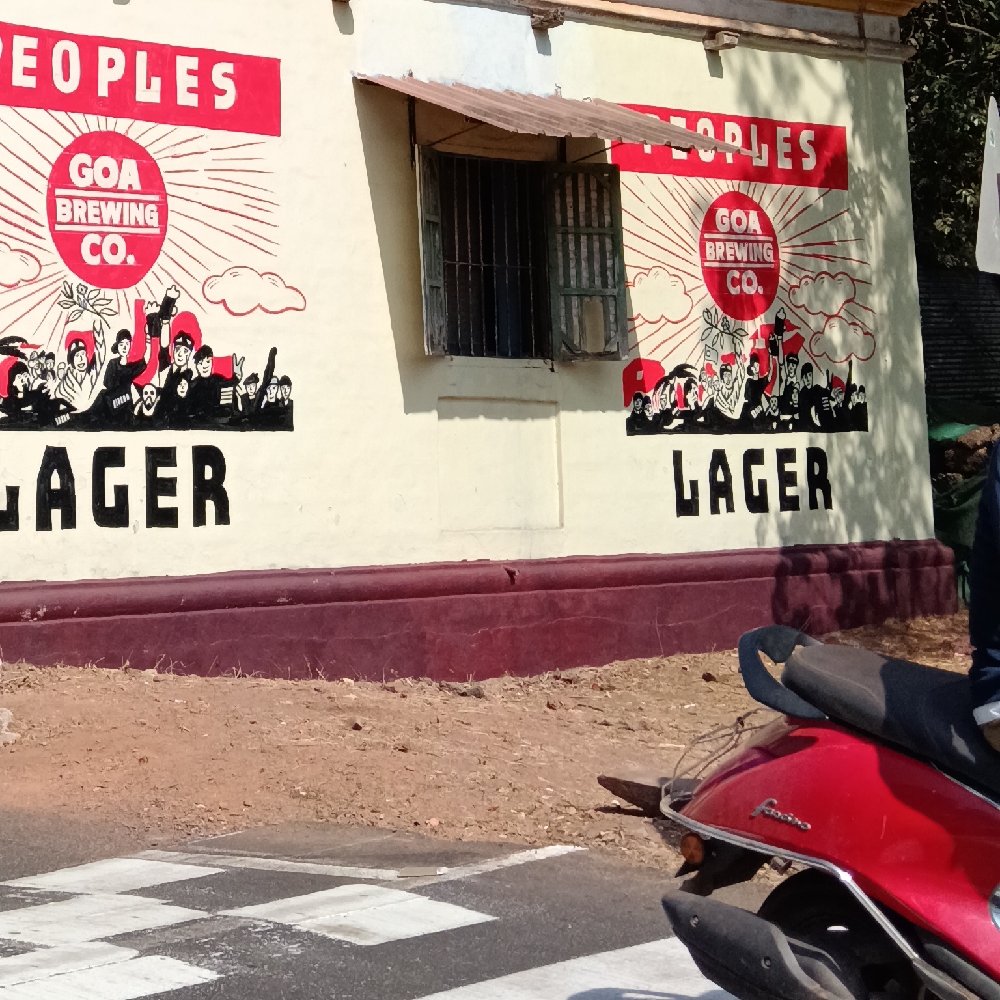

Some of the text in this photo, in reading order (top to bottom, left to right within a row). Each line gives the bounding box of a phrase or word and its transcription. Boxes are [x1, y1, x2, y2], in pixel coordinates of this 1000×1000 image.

[642, 113, 817, 171] EOPLES
[69, 153, 142, 191] GOA
[55, 196, 160, 228] BREWING
[715, 207, 763, 235] GOA
[81, 233, 136, 266] CO.
[705, 241, 774, 263] BREWING
[726, 269, 764, 295] CO.
[672, 446, 833, 518] LAGER
